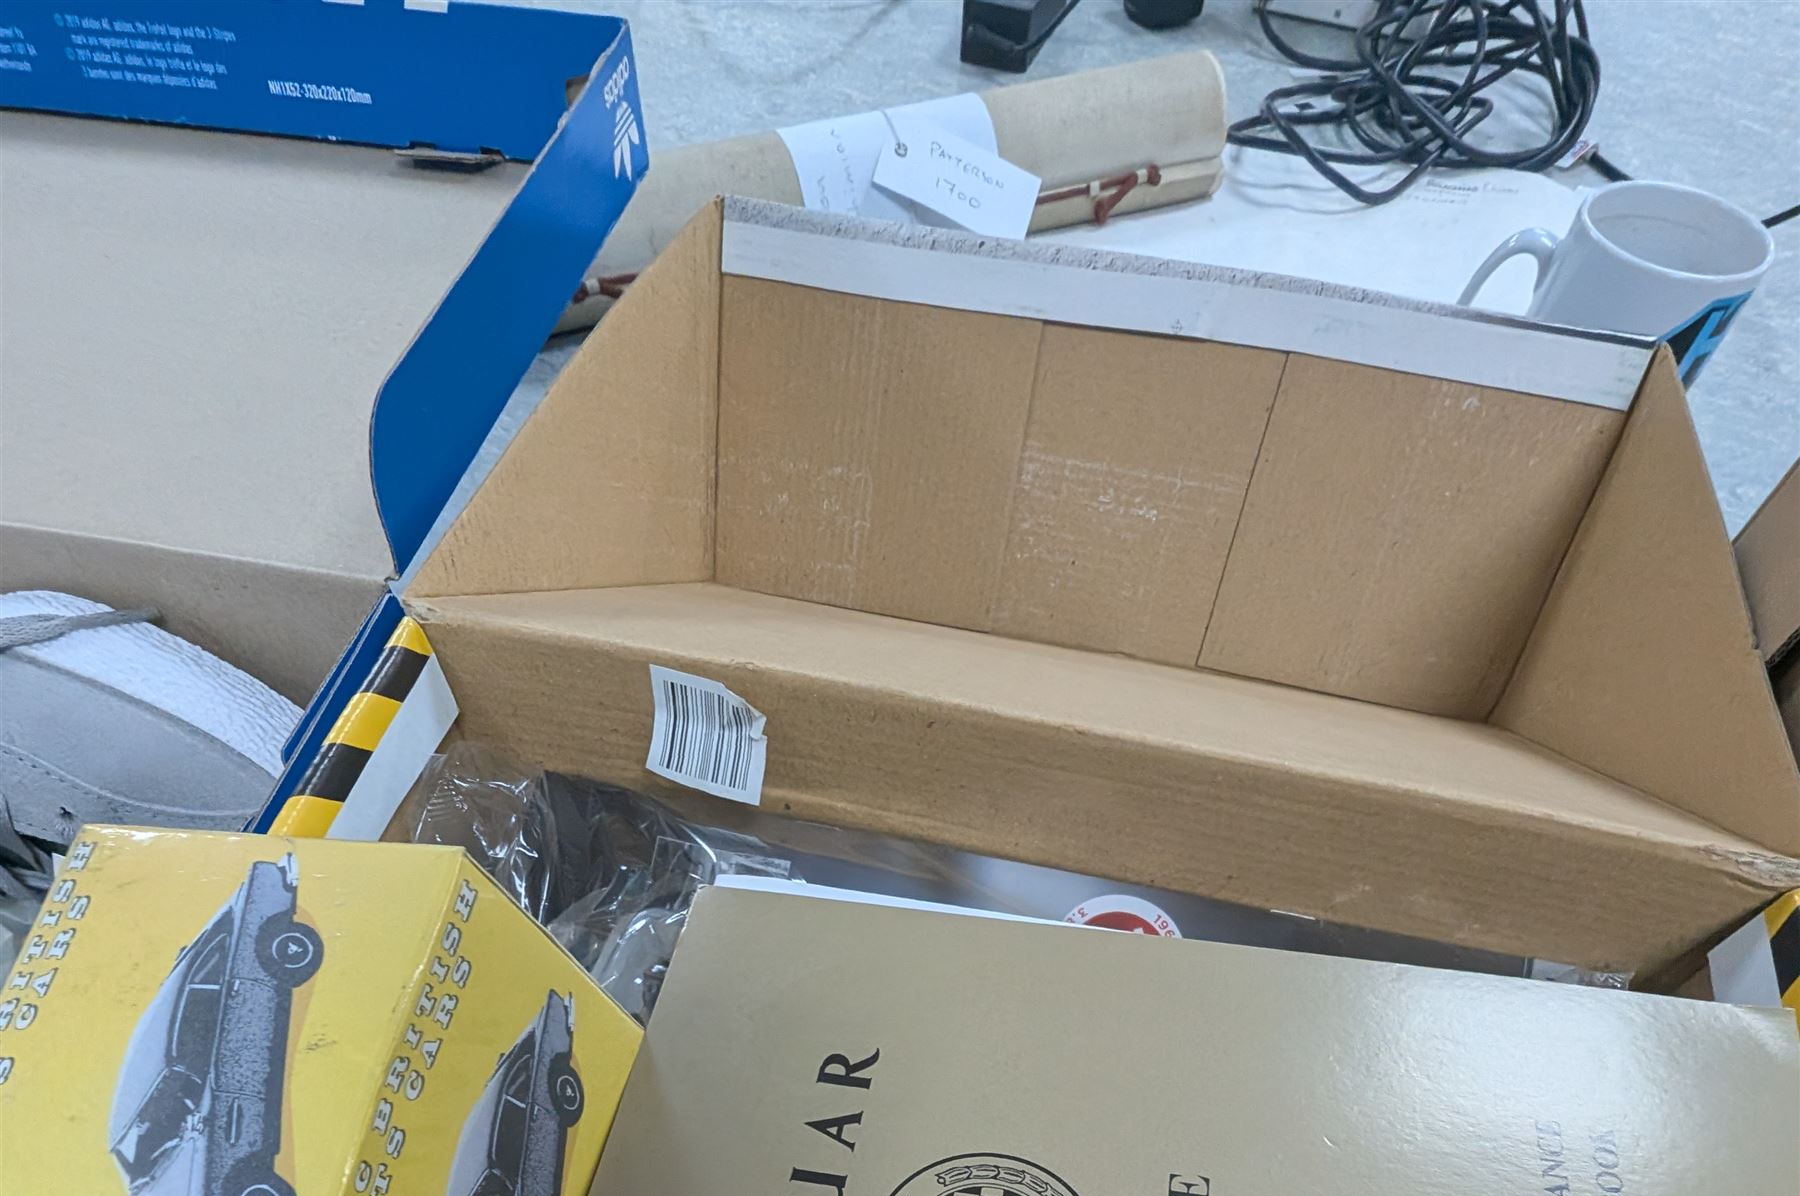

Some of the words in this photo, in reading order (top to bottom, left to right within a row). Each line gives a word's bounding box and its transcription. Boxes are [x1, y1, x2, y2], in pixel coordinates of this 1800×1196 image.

[604, 56, 630, 109] adidas
[935, 176, 981, 210] 1700
[15, 894, 91, 1031] CARS
[372, 879, 478, 1137] BRITISH
[405, 955, 472, 1102] CARS
